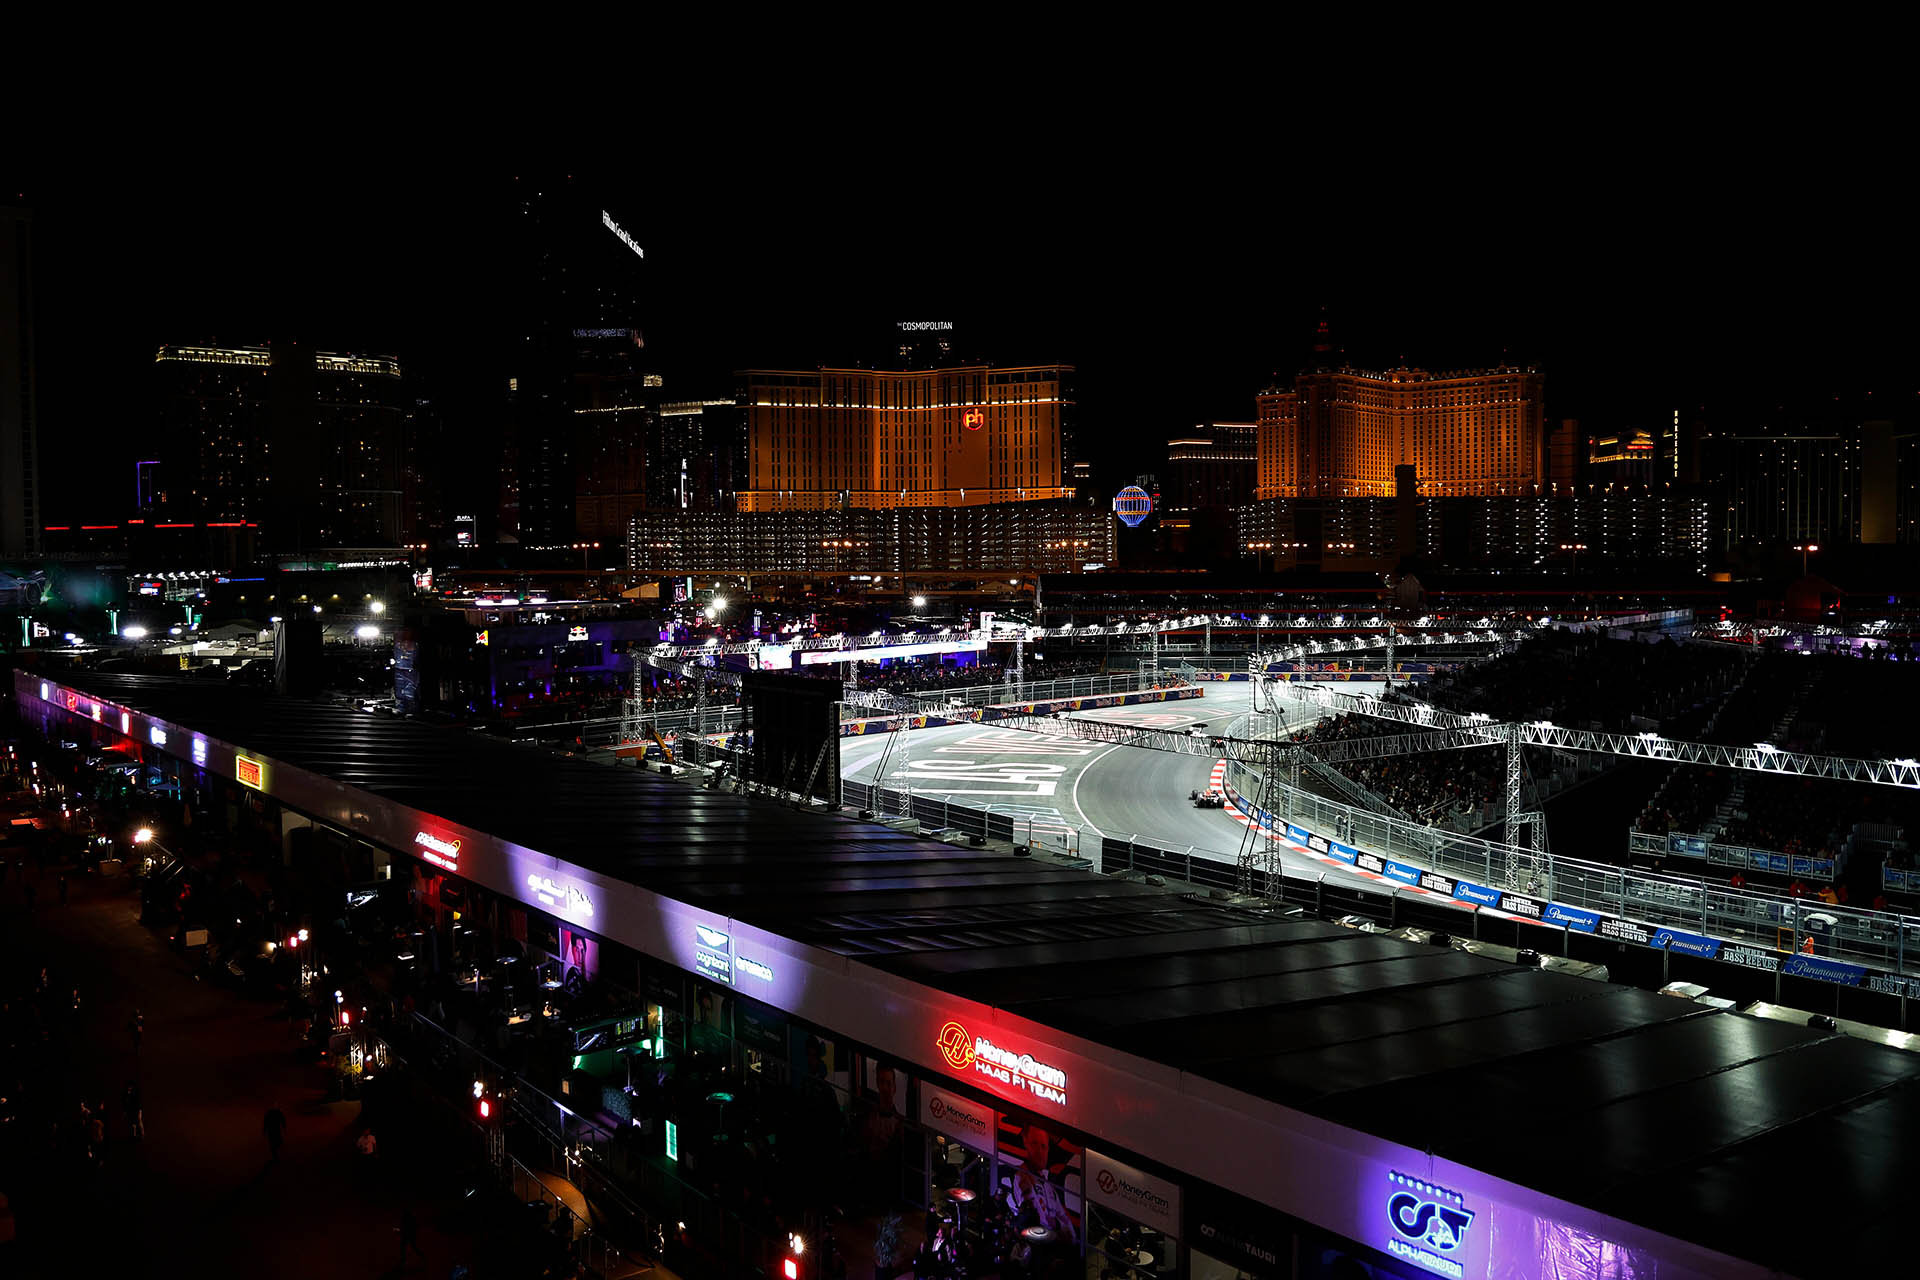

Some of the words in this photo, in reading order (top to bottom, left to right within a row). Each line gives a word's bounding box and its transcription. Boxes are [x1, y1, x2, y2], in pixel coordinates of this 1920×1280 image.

[903, 321, 953, 331] COSMOPOLITAN
[1723, 950, 1745, 964] BASS
[1745, 956, 1778, 971] REEVES
[1870, 978, 1895, 993] BASS
[975, 1036, 1067, 1088] MoneyGram
[975, 1060, 1011, 1084] HAAS
[1012, 1074, 1026, 1090] F1
[1026, 1080, 1067, 1106] TEAM
[946, 1104, 986, 1129] MoneyGram
[1118, 1179, 1169, 1209] MoneyGram
